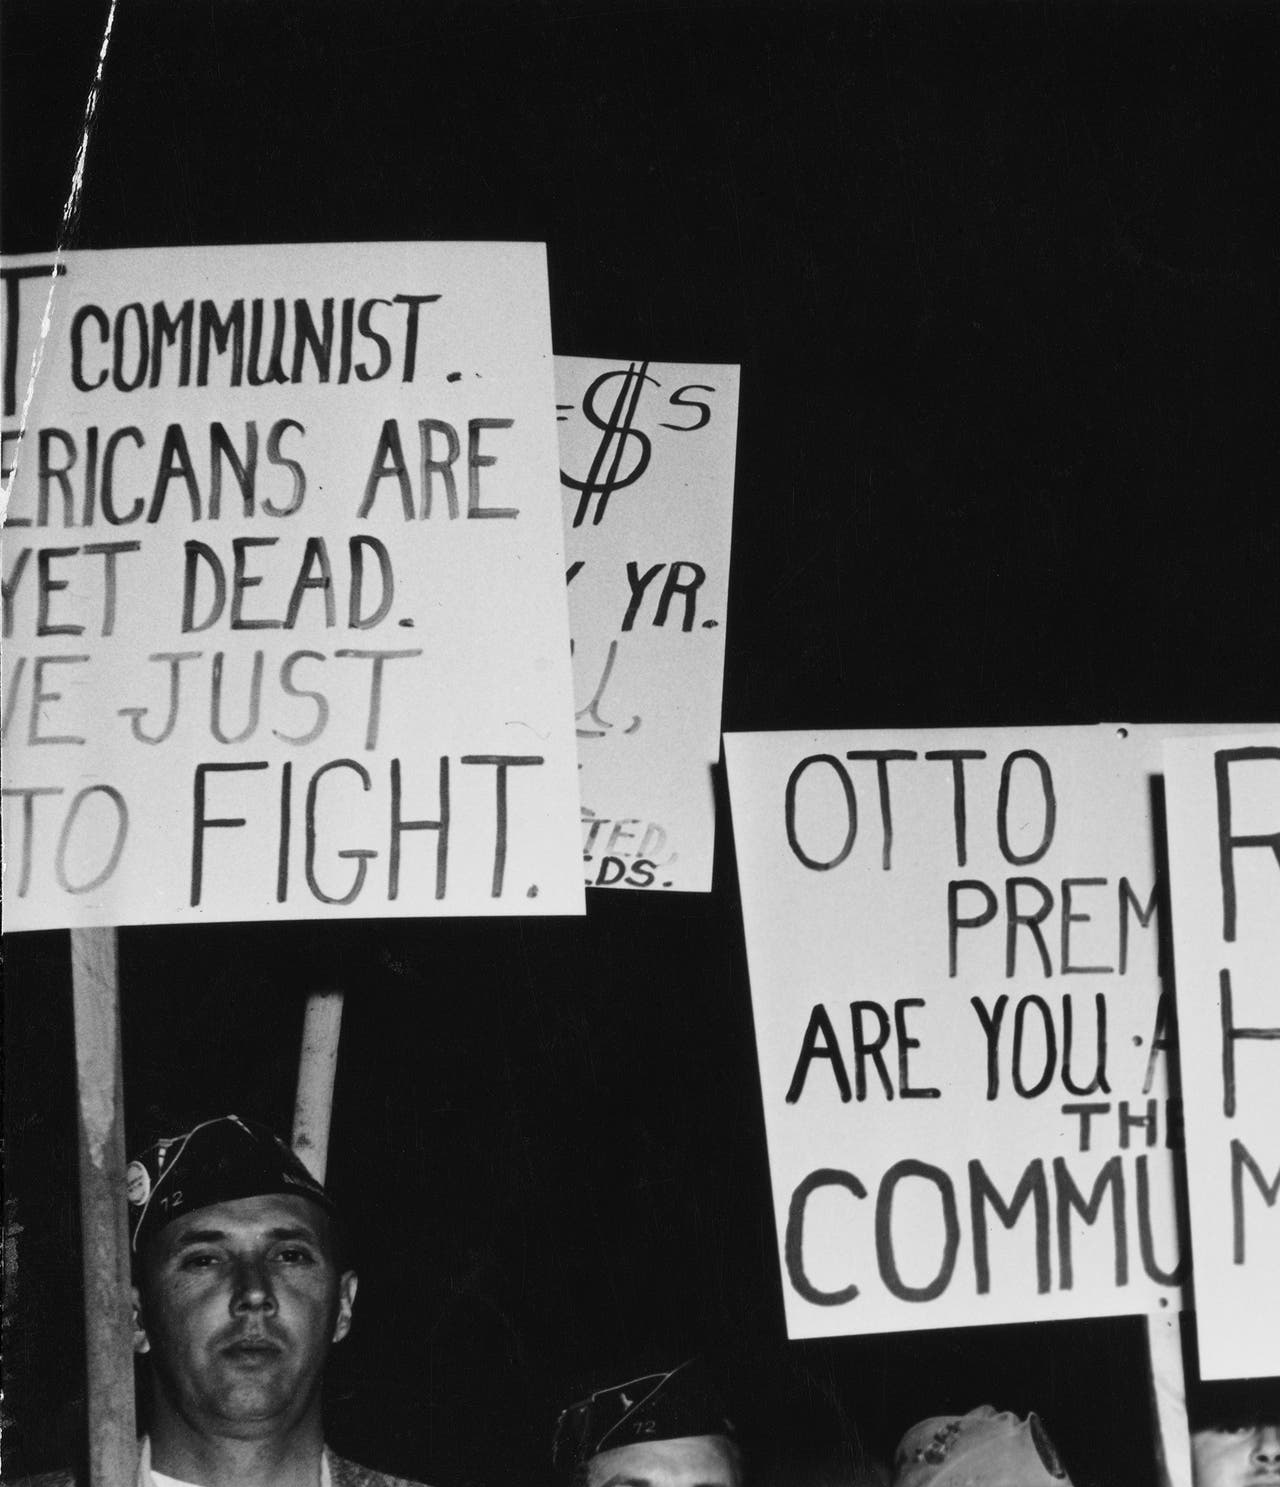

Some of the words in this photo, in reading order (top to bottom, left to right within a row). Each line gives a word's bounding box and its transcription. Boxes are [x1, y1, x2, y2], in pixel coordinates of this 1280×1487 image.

[70, 294, 463, 392] COMMUNIST.
[356, 418, 520, 521] ARE
[182, 536, 415, 636] DEAD.
[621, 561, 719, 632] YR.
[118, 649, 422, 749] JUST
[1, 784, 128, 895] TO
[190, 755, 544, 908] FIGHT.
[785, 748, 1056, 871] OTTO
[786, 998, 941, 1104] ARE
[971, 992, 1111, 1101] YOU
